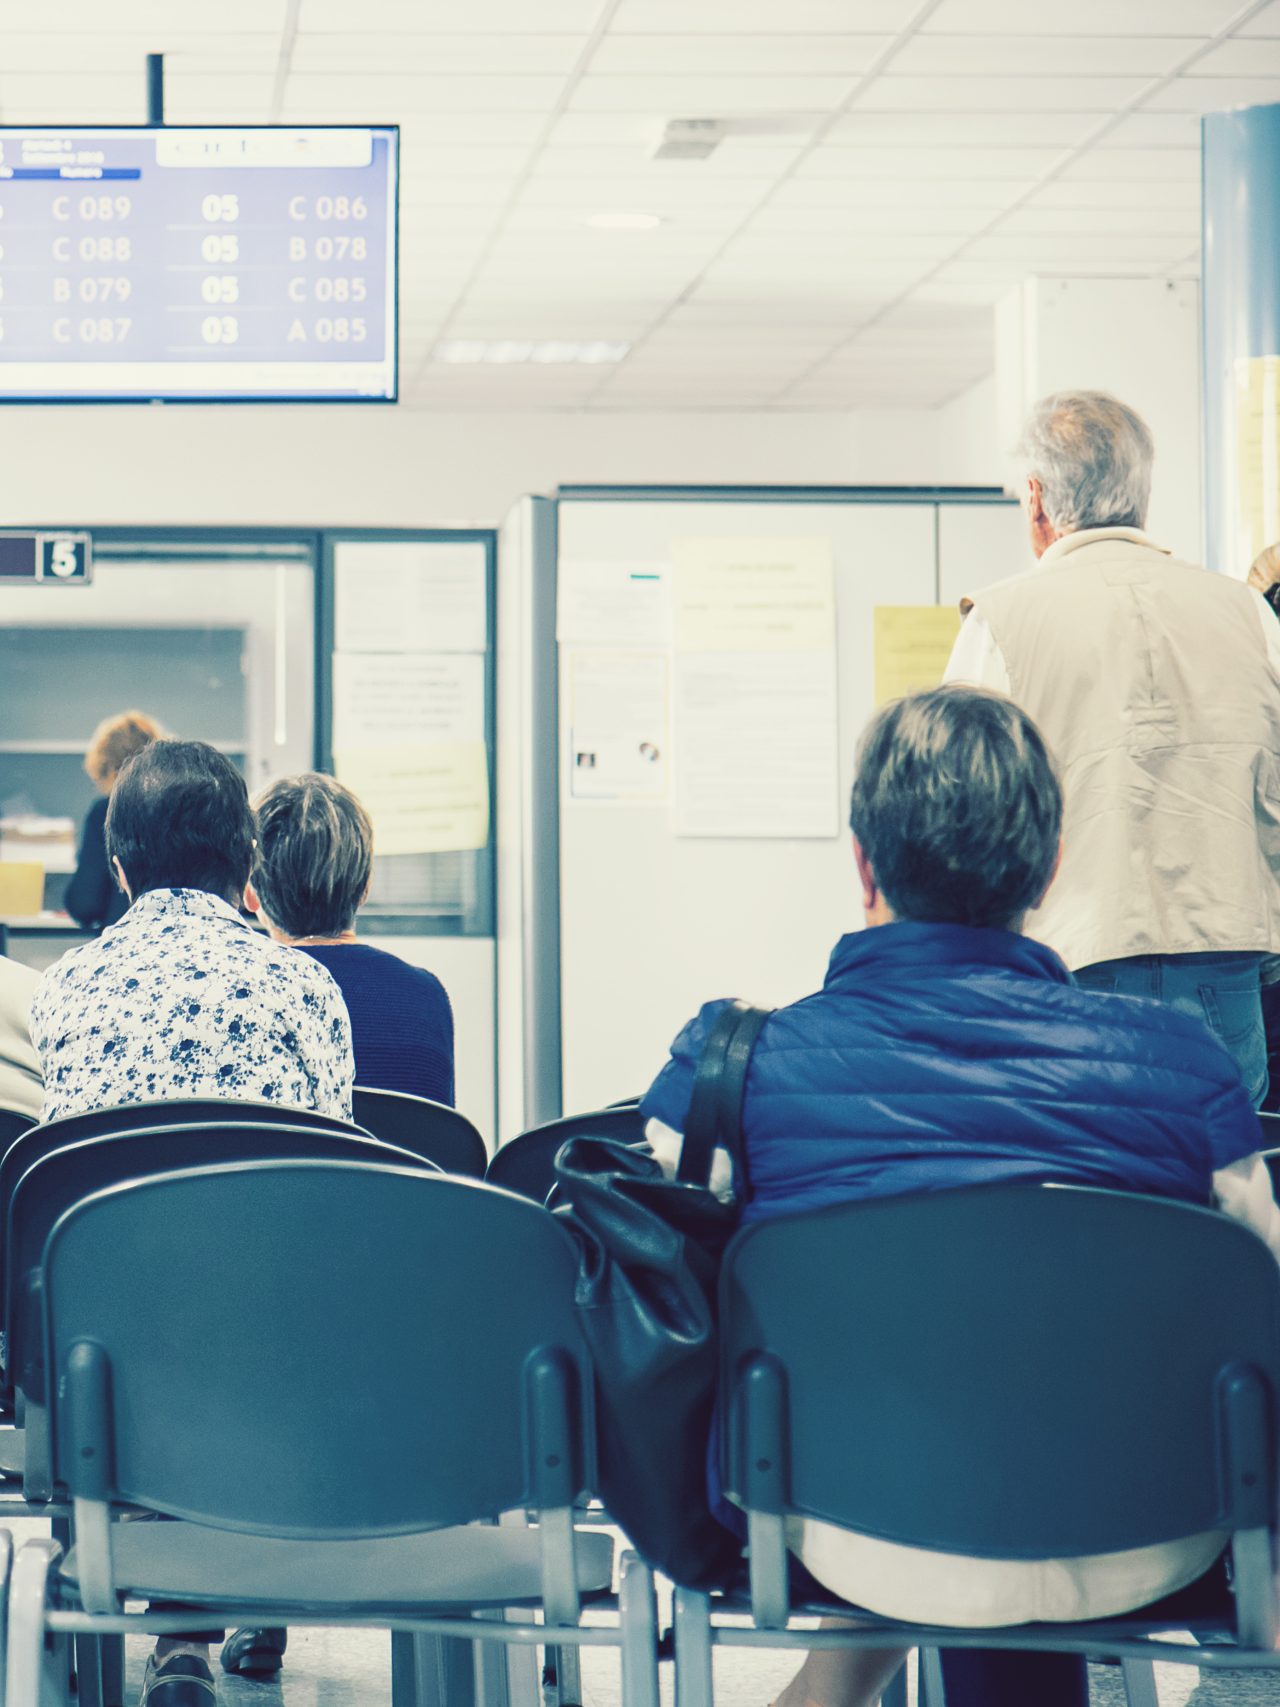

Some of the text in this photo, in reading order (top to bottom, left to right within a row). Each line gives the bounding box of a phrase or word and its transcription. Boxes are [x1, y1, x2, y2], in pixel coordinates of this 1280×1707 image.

[51, 196, 70, 221] C
[78, 196, 132, 221] 089
[201, 194, 368, 223] 05 C 086
[51, 237, 71, 261] C
[78, 237, 132, 261] 088
[201, 234, 367, 263] 05 B 078
[53, 277, 72, 302] B
[79, 277, 132, 302] 079
[201, 275, 367, 304] 05 C 085
[52, 318, 71, 343] C
[79, 318, 132, 343] 087
[201, 315, 367, 344] 03 A 085
[51, 540, 77, 577] 5
